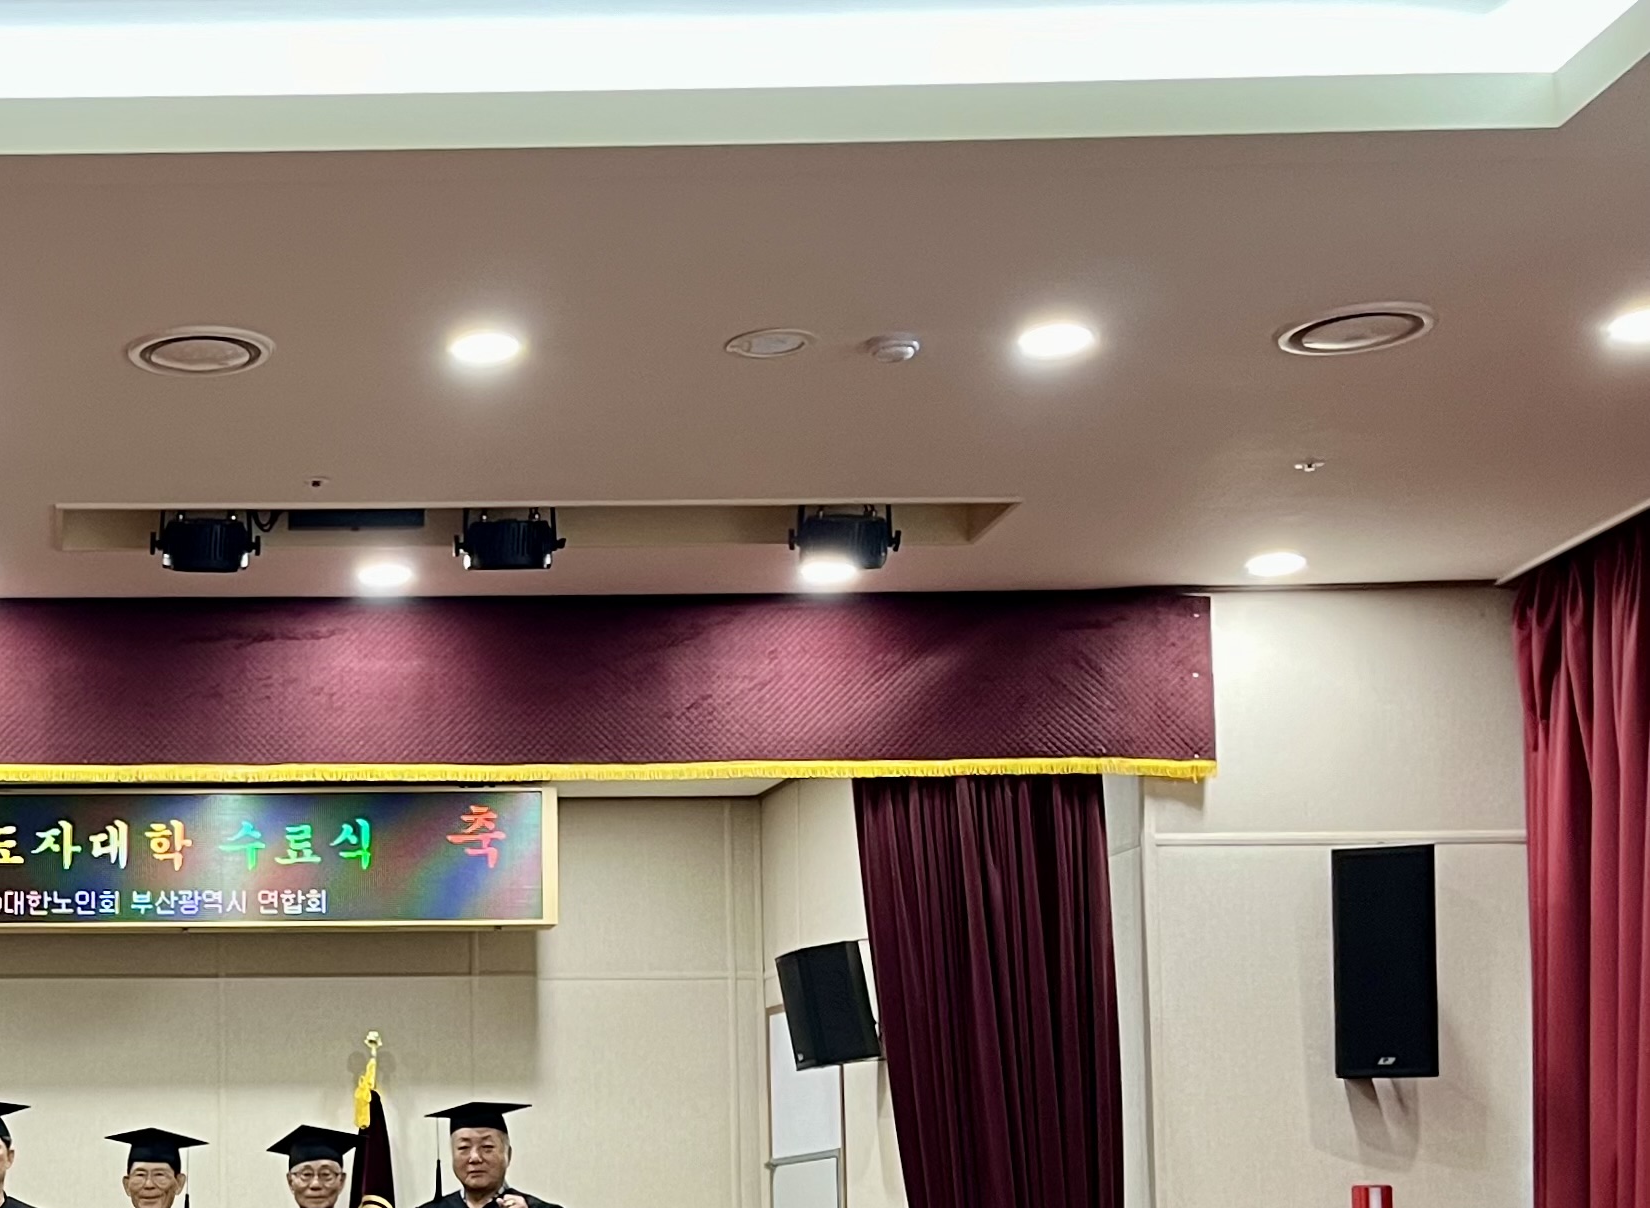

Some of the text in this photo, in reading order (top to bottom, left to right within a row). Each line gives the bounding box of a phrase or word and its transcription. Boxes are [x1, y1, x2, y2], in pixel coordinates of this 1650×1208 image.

[218, 817, 374, 871] 수료식
[446, 804, 507, 869] 축
[130, 889, 247, 916] 부산광역시
[257, 888, 328, 916] 연합회
